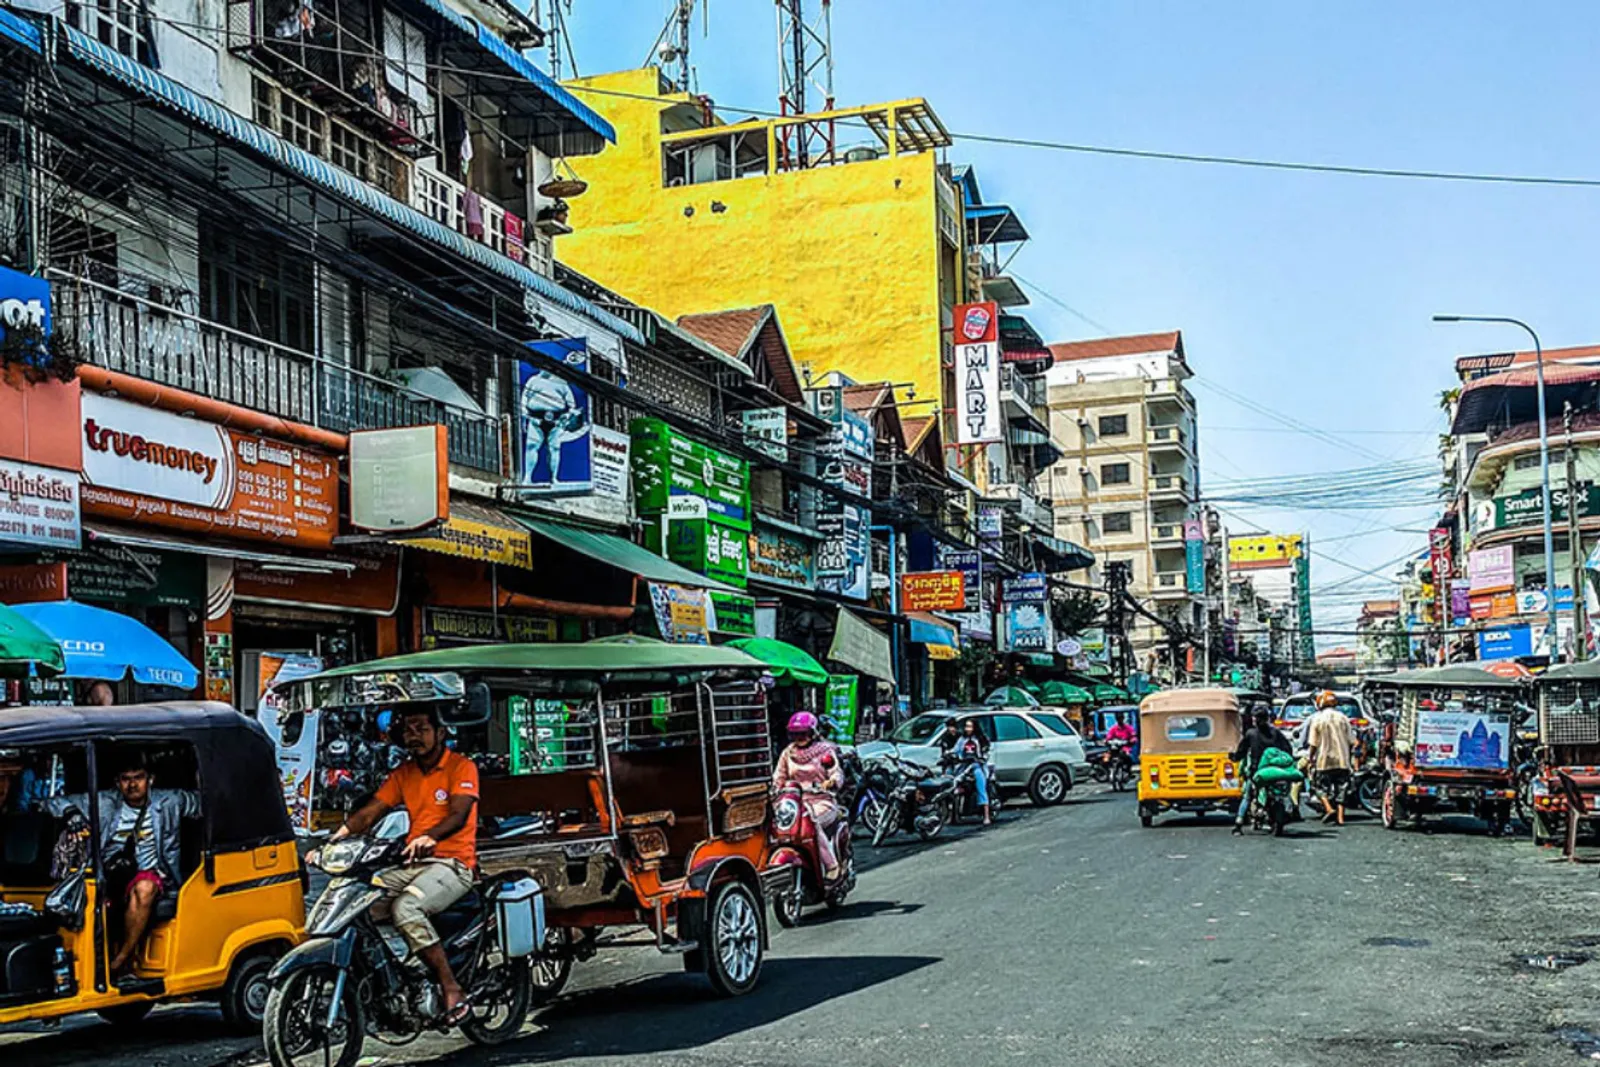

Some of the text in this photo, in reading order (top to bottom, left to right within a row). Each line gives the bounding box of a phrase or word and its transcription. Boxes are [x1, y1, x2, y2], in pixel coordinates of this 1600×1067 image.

[964, 344, 988, 438] MART
[84, 418, 218, 485] truemoney
[672, 501, 700, 514] Wing
[1504, 495, 1543, 512] Smart
[44, 506, 76, 522] SHOP
[62, 639, 105, 652] CNO
[148, 667, 183, 683] TECNO
